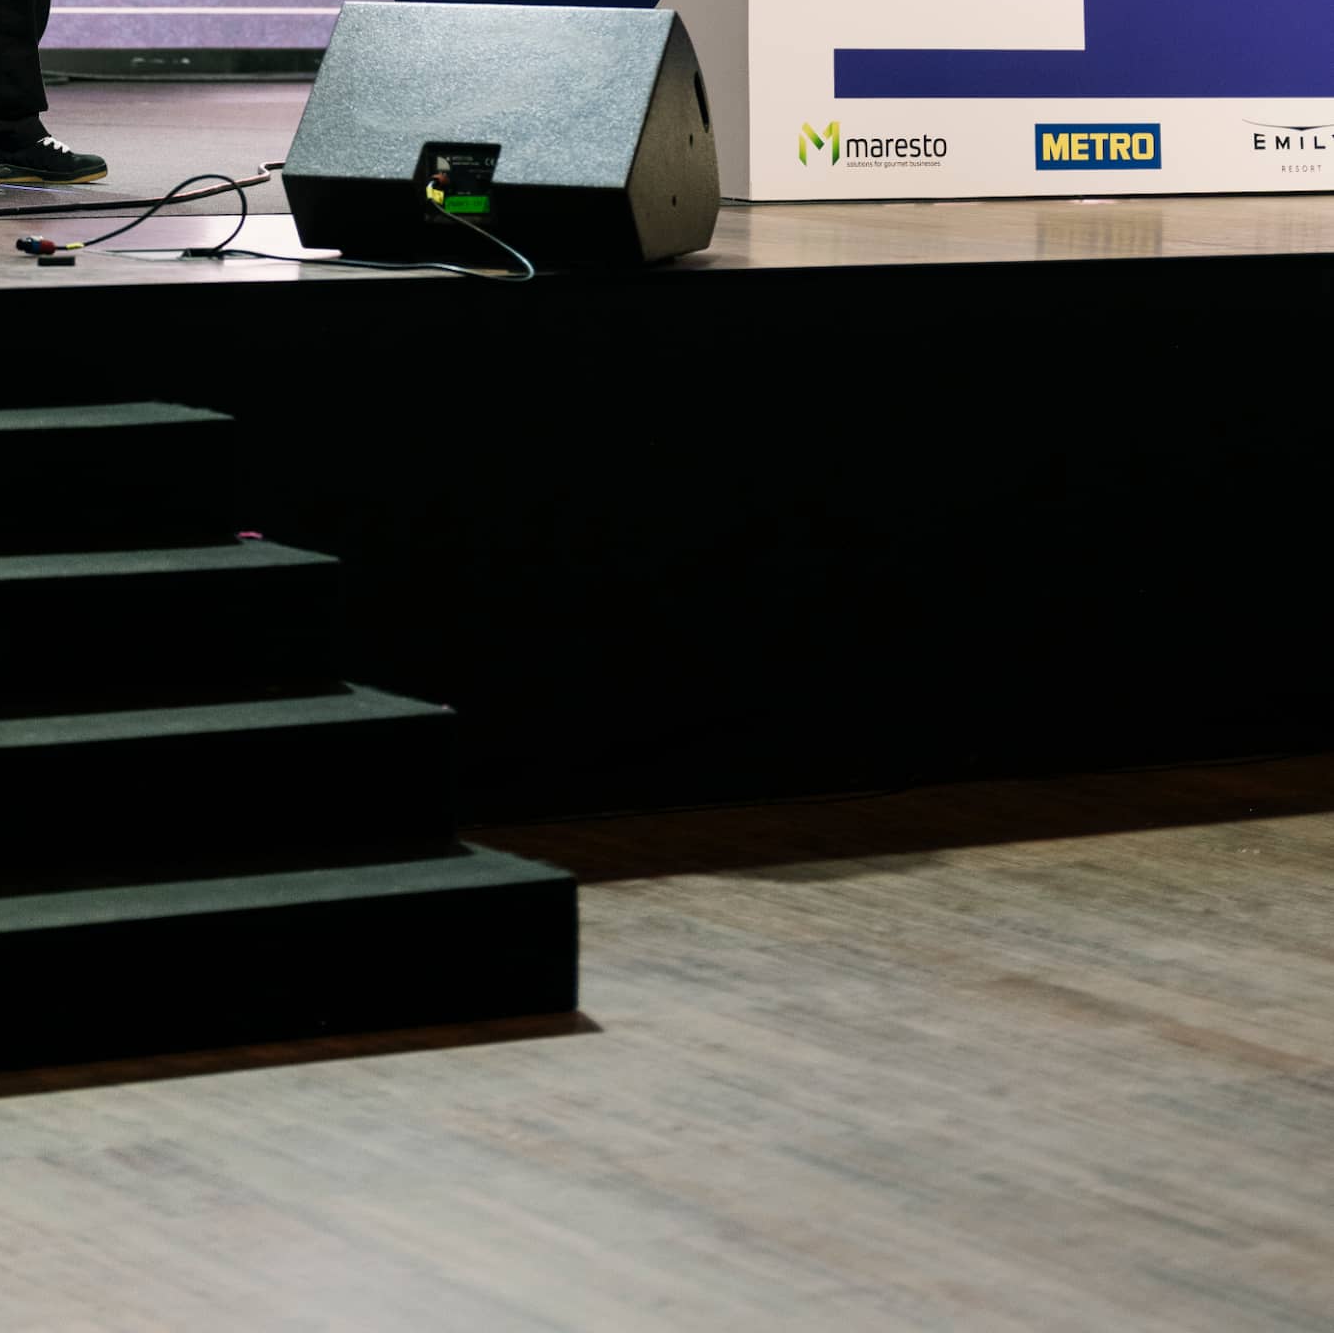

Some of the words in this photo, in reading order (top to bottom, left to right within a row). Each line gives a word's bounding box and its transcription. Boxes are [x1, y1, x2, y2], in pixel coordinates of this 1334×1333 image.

[846, 134, 947, 158] maresto
[1042, 132, 1155, 161] METRO
[1281, 165, 1323, 174] RESORT
